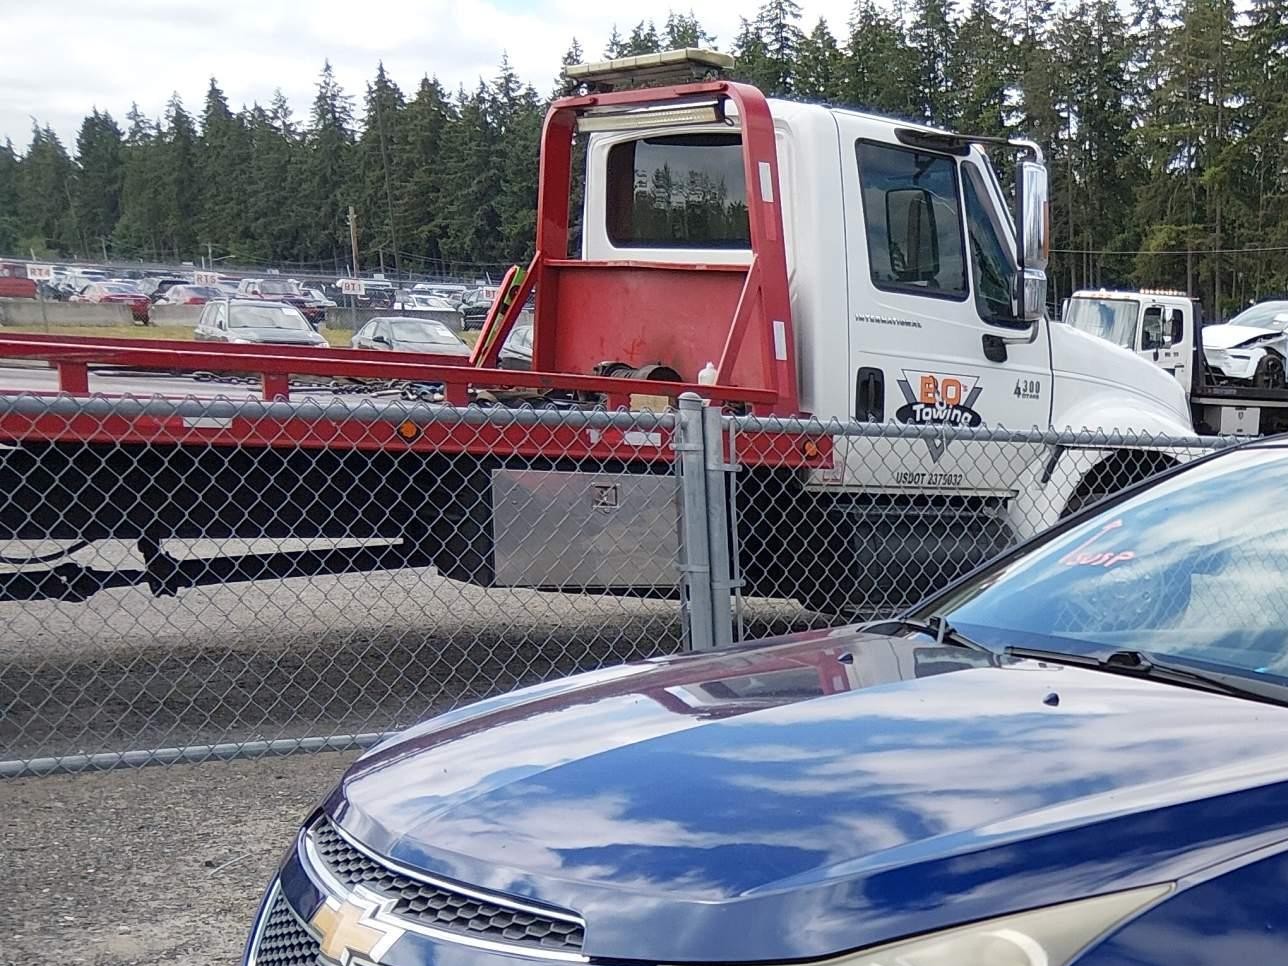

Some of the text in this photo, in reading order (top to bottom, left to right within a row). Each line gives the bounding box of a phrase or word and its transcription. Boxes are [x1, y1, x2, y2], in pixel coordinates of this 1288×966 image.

[344, 282, 361, 291] BT1
[1013, 378, 1040, 398] 4300
[896, 471, 926, 485] USDOT
